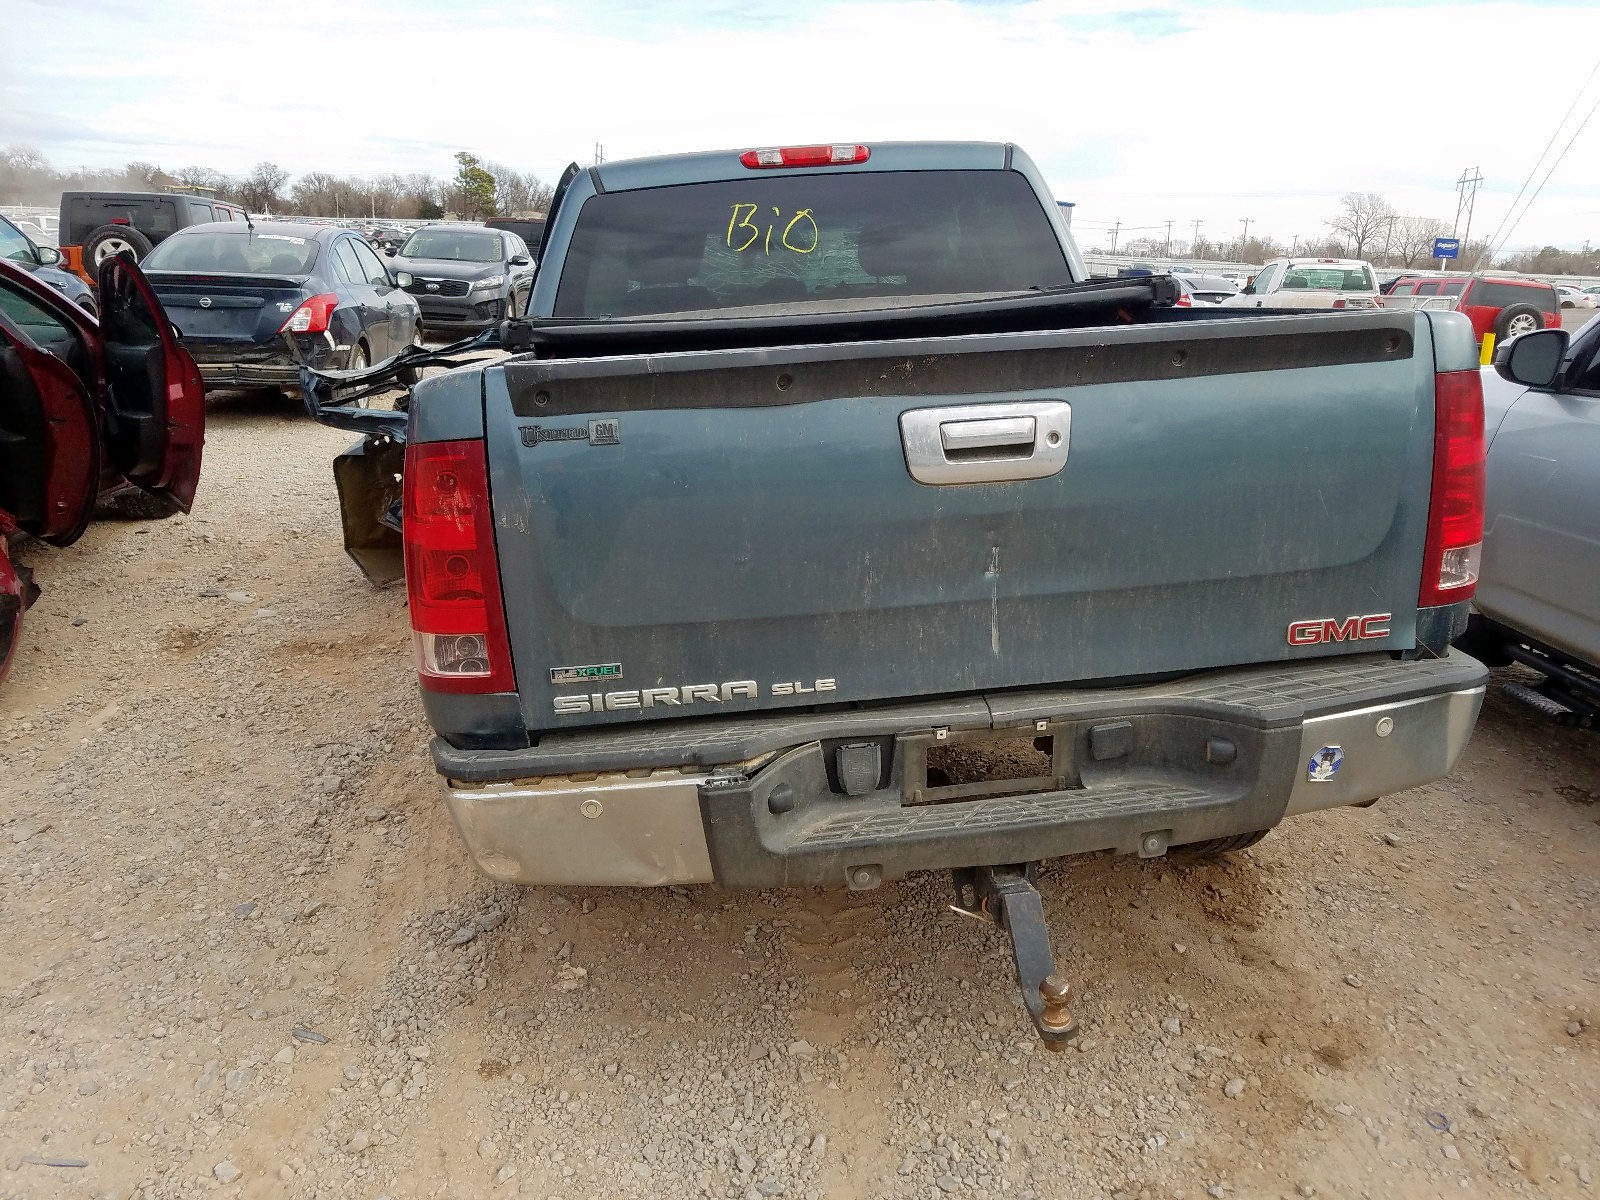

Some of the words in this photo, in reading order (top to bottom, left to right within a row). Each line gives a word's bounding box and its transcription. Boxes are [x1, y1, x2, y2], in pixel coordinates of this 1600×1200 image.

[595, 423, 614, 436] GM
[1288, 613, 1392, 646] GMC
[553, 680, 758, 715] SIERRA
[771, 678, 837, 696] SLE
